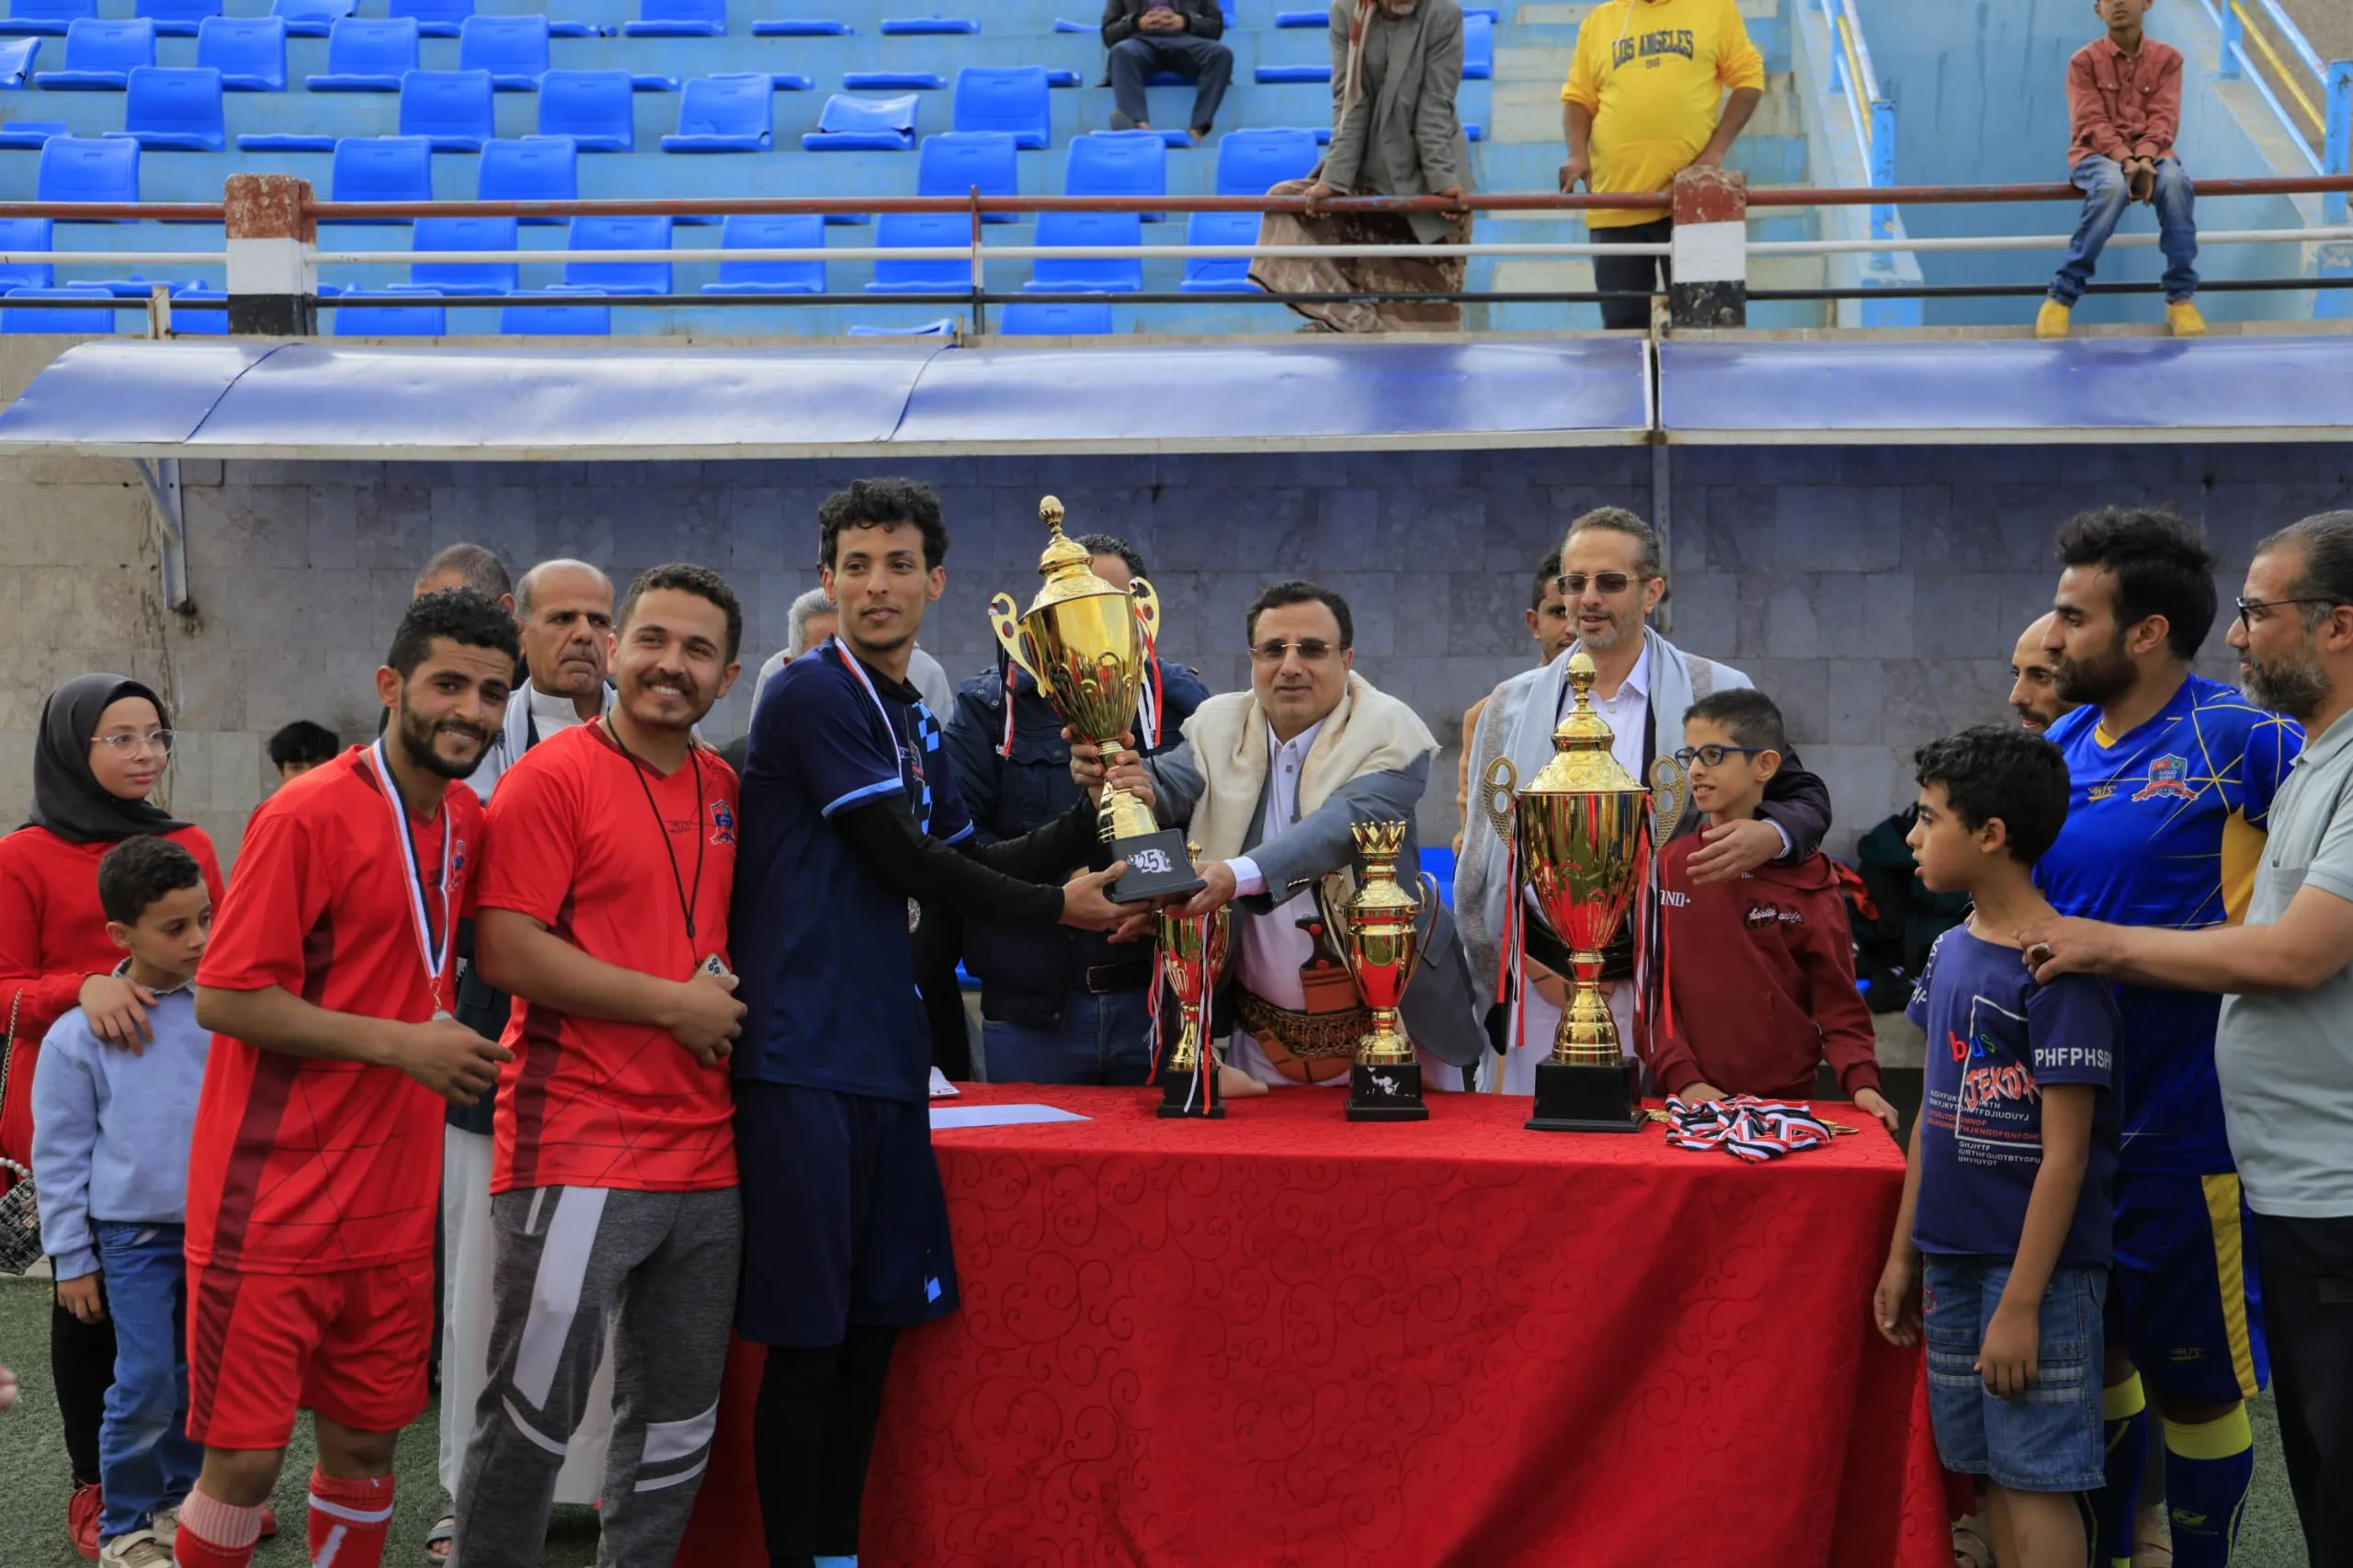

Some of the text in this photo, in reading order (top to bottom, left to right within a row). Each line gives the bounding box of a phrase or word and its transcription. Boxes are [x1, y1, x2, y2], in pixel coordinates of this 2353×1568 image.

[1612, 29, 1694, 71] LOS ANGELES
[1138, 851, 1160, 871] 25
[1949, 1030, 1995, 1063] bus
